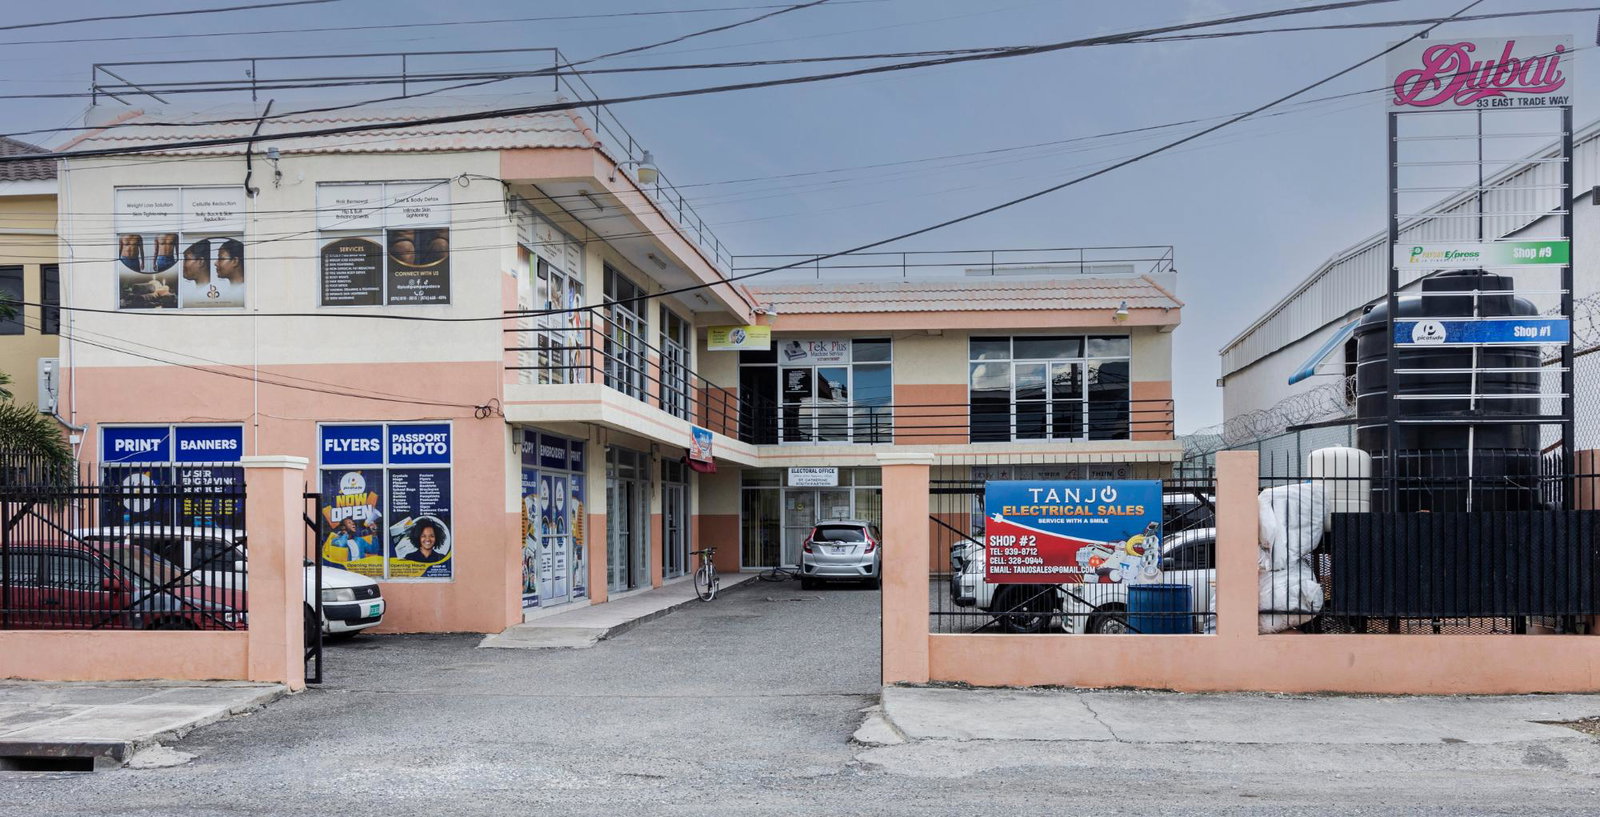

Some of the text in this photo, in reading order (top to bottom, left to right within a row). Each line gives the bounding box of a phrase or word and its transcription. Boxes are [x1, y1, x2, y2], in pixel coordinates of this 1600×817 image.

[1393, 40, 1565, 107] Dubai
[1477, 96, 1570, 108] 33 EAST TRADE WAY
[1513, 247, 1552, 259] Shop #9
[1514, 326, 1550, 338] Shop #1
[808, 341, 847, 352] Tek Plus
[392, 433, 447, 443] PASSPORT
[115, 438, 237, 452] PRINT BANNERS
[325, 438, 380, 452] FLYERS
[392, 442, 447, 455] PHOTO
[336, 493, 367, 508] NOW
[331, 504, 373, 523] OPEN
[1003, 505, 1144, 516] ELECTRICAL SALES
[989, 535, 1036, 546] SHOP #2
[990, 548, 1003, 556] TEL:
[1014, 566, 1095, 574] TANJOSALES@GMAIL.COM
